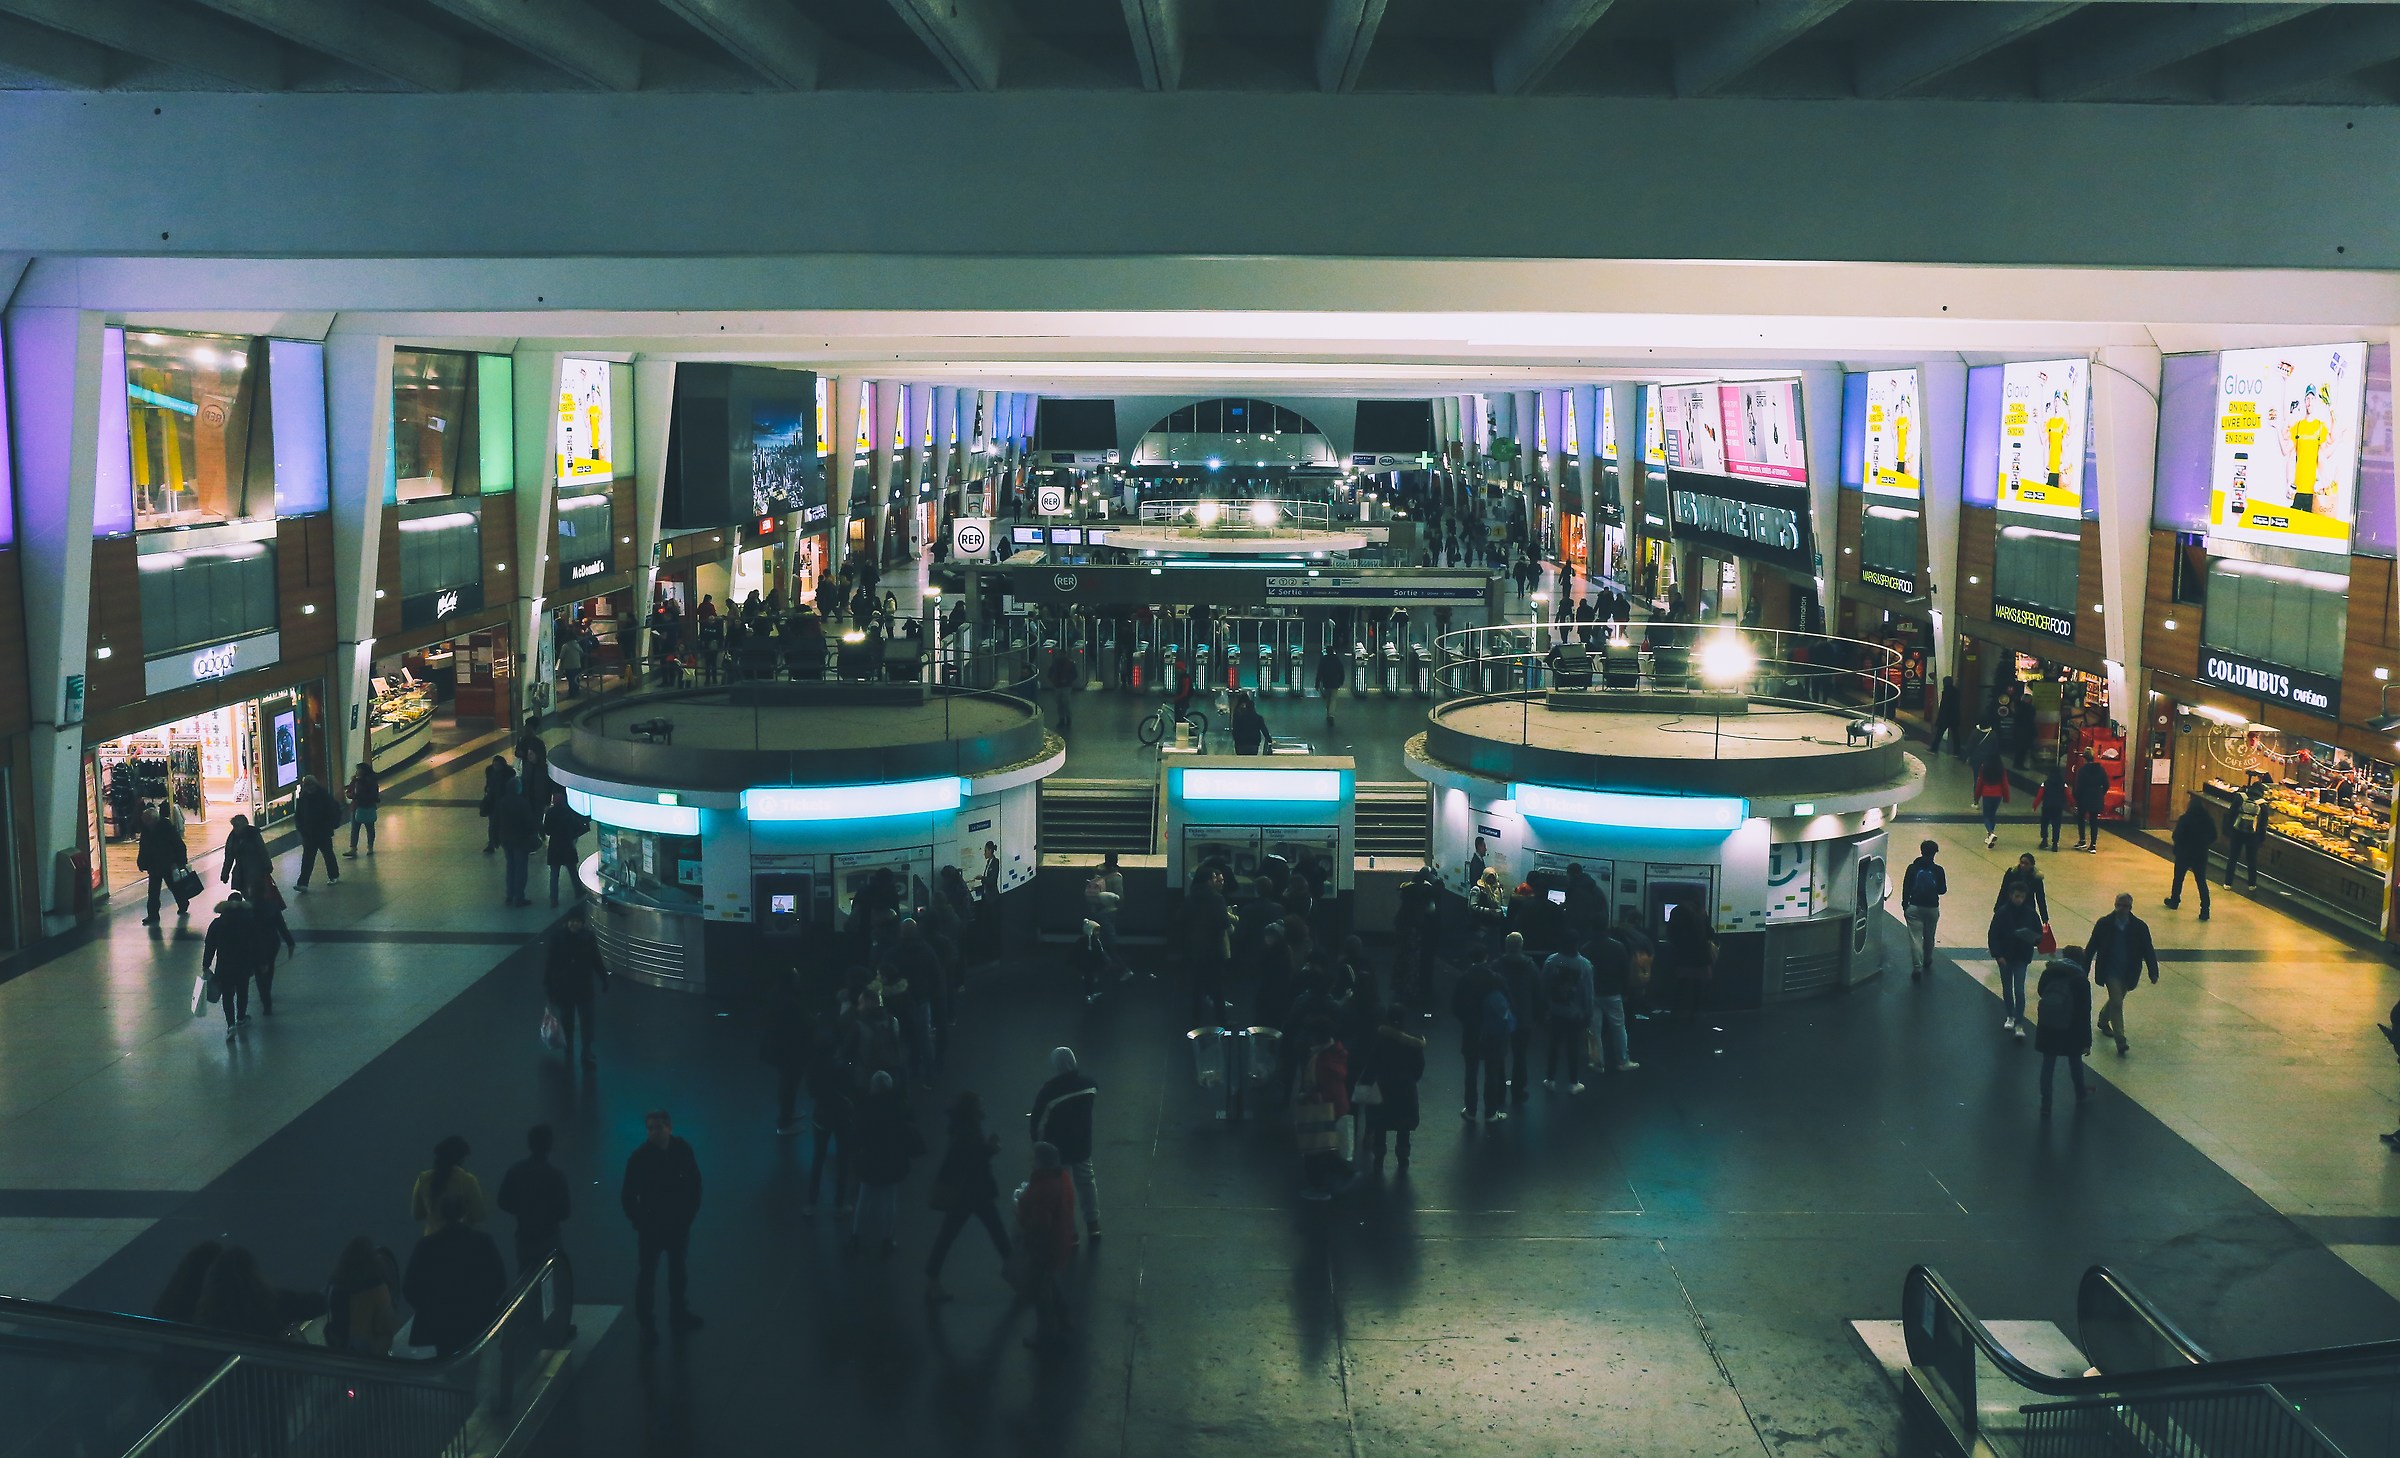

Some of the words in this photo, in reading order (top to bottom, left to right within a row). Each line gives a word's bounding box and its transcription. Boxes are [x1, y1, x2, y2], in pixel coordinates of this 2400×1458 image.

[2006, 382, 2029, 398] Glovo
[2224, 375, 2262, 395] Glovo
[2229, 403, 2239, 412] ON
[2240, 403, 2256, 413] VOUS
[2221, 418, 2240, 428] LIVRE
[2243, 417, 2261, 427] TOUT
[2225, 434, 2233, 443] EN
[962, 534, 981, 544] RER
[572, 560, 604, 579] McDonald's
[2208, 658, 2289, 697] COLUMBUS
